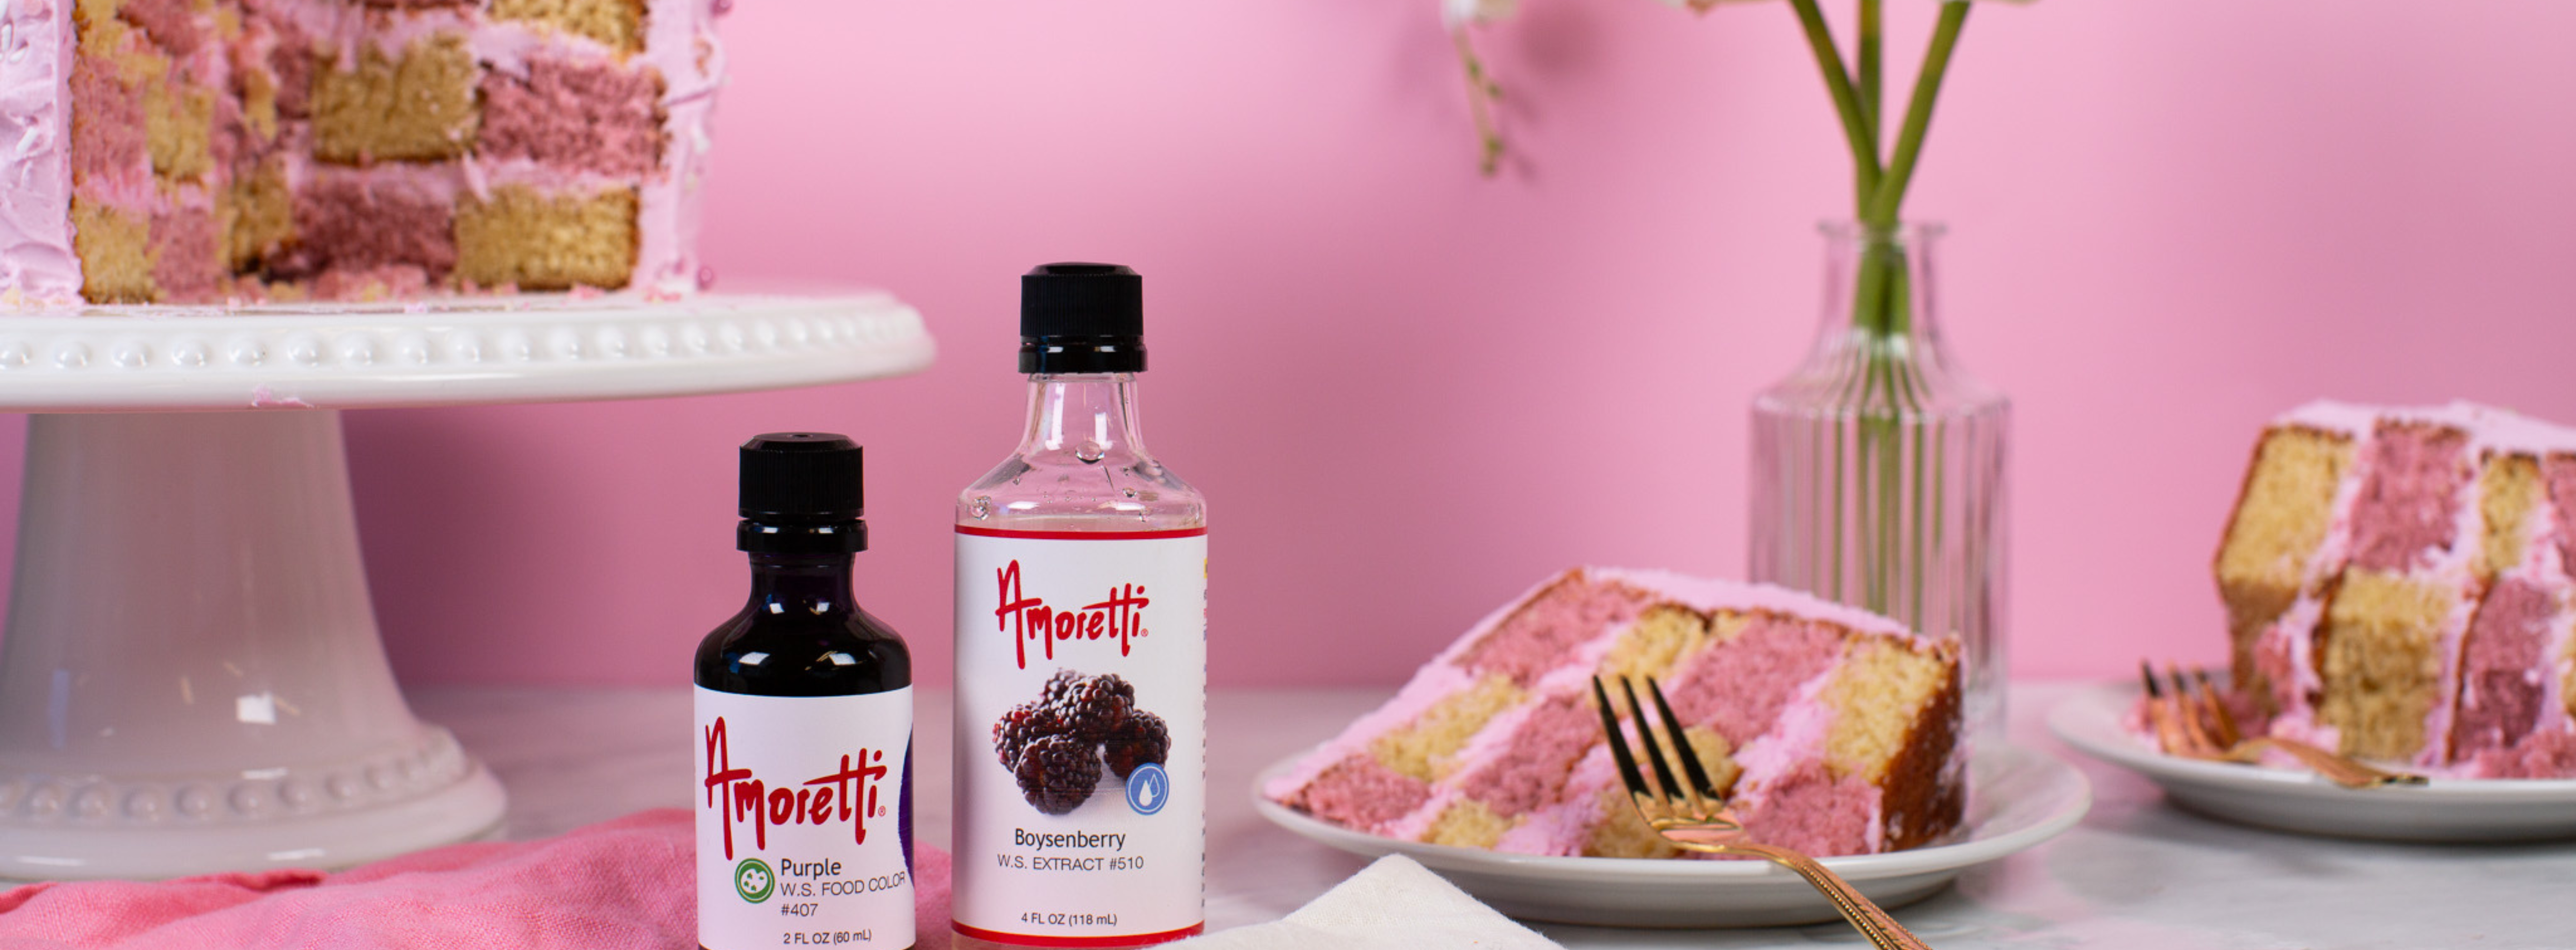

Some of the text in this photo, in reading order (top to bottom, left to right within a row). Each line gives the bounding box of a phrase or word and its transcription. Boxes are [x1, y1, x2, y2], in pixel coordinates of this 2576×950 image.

[1015, 828, 1126, 851] Boysenberry
[781, 858, 842, 881] Purple
[997, 854, 1144, 871] W.S. EXTRACT #510
[780, 871, 905, 897] W.S. FOOD COLOR
[781, 904, 818, 917] #407
[1021, 912, 1118, 927] 4 FL OZ (118 mL)
[783, 929, 872, 945] 2 FL OZ (60 mL)
